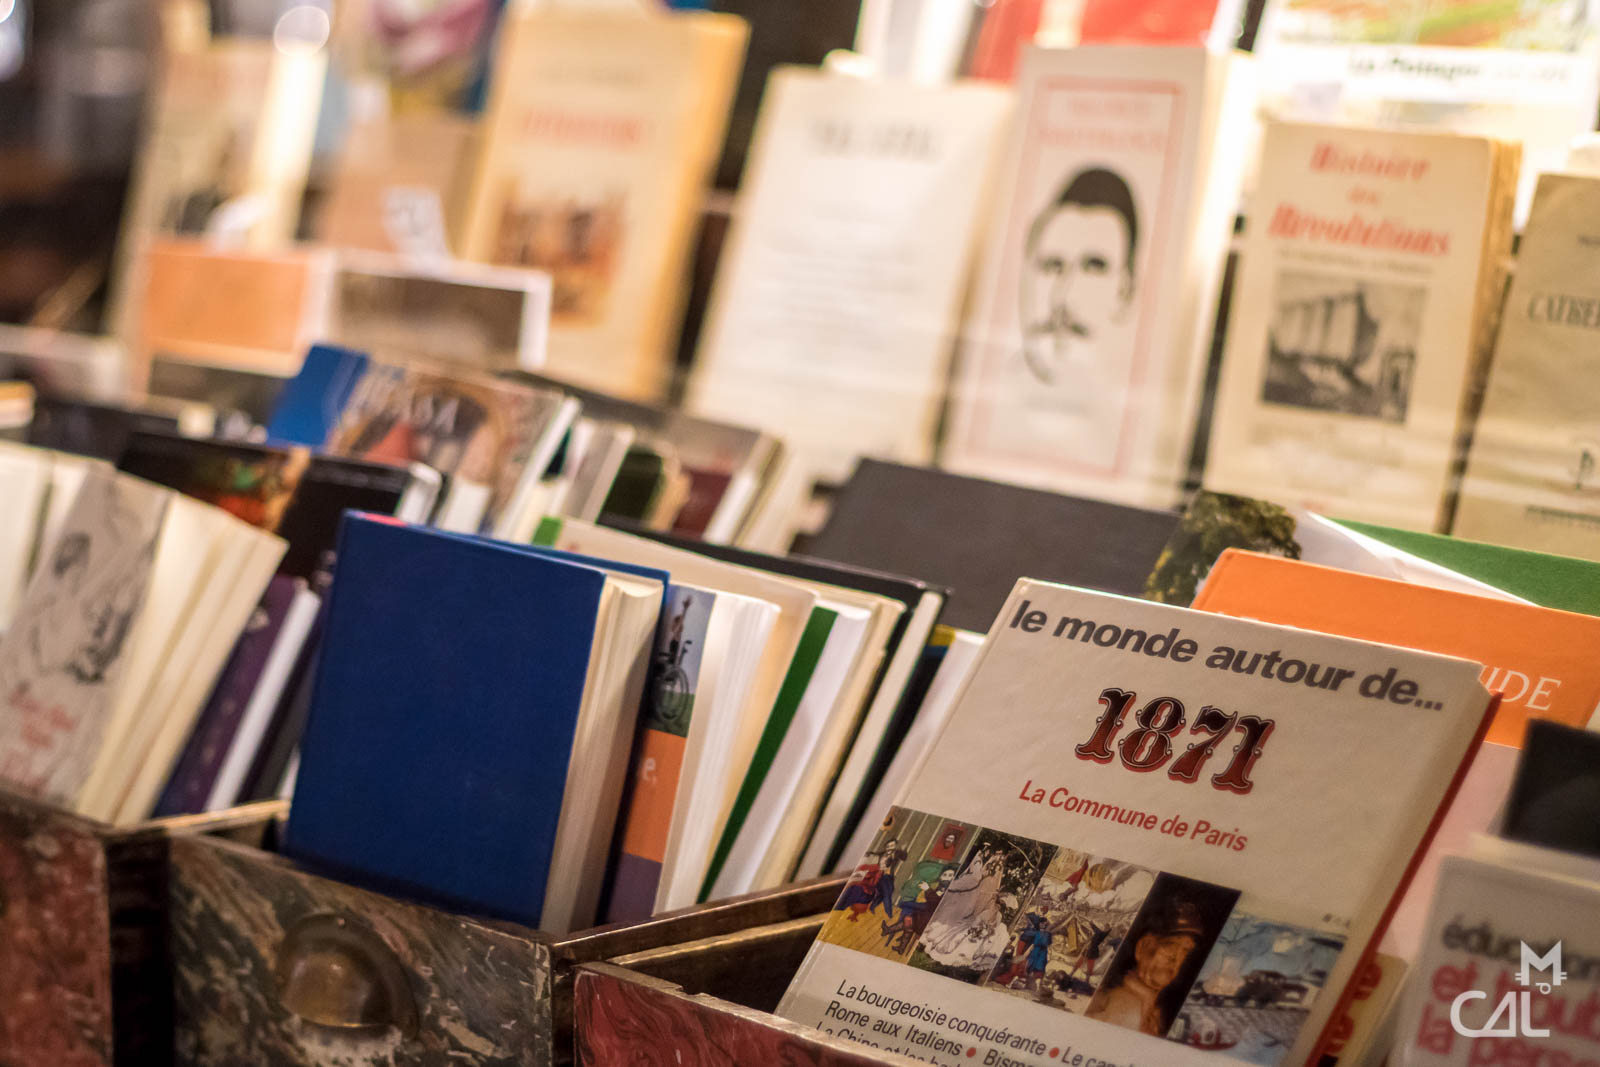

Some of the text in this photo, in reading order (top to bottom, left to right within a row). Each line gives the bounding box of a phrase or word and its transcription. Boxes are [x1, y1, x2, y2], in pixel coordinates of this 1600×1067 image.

[1009, 600, 1444, 711] le monde autour de...
[1479, 664, 1562, 711] IDE
[1074, 687, 1276, 795] 1871
[1018, 779, 1248, 852] La Commune de Paris
[825, 1000, 870, 1027] Rome
[872, 1019, 902, 1038] aux
[905, 1024, 963, 1056] Italiens
[836, 979, 857, 998] La
[856, 984, 947, 1026] bourgeoisie
[947, 1016, 1046, 1056] conquérante
[1061, 1046, 1083, 1066] Le
